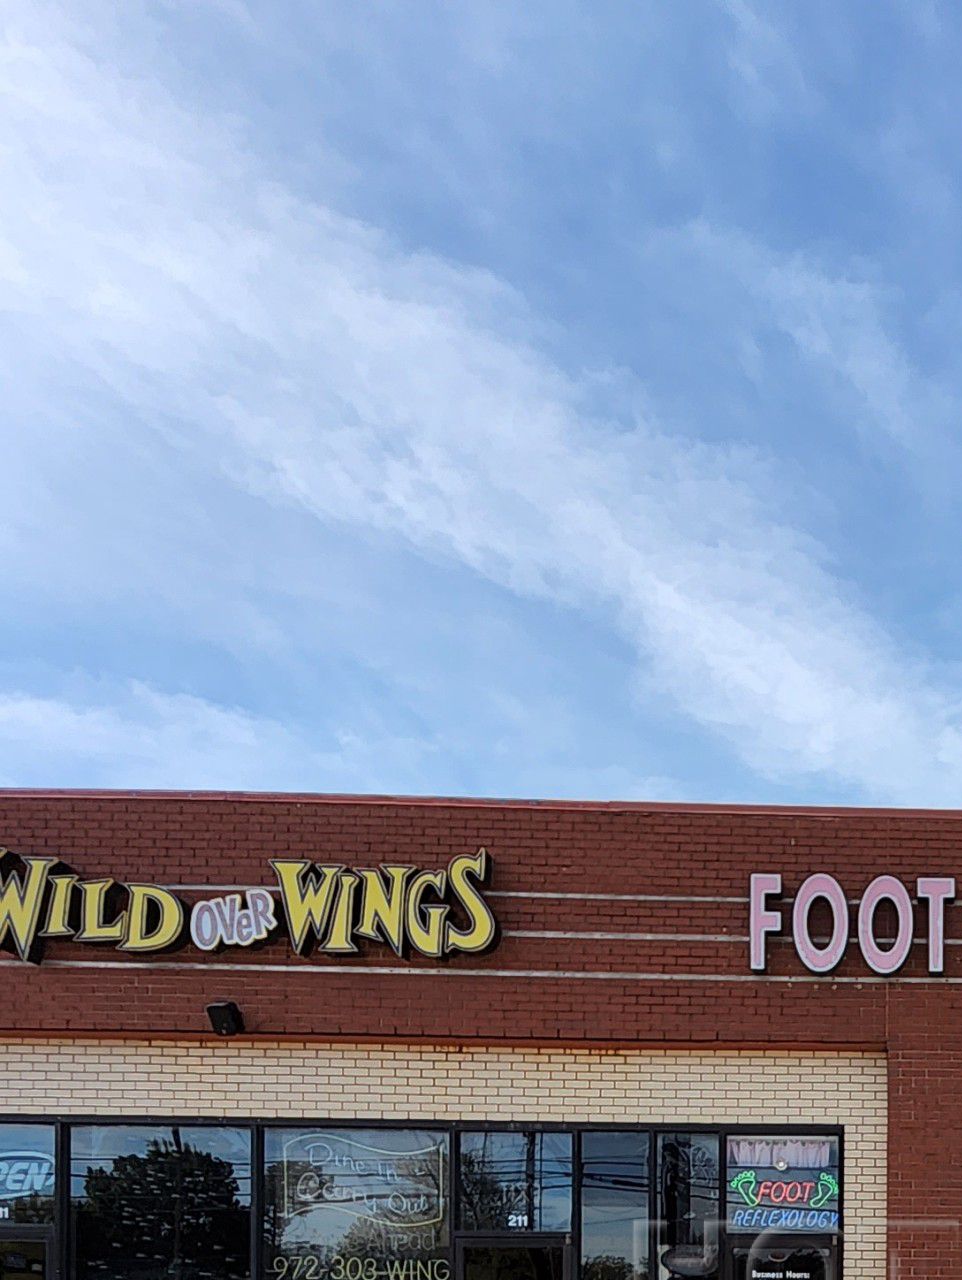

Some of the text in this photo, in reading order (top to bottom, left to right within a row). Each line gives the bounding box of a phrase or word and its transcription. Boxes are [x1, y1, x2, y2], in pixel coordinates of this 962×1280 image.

[268, 847, 495, 957] WINGS
[749, 873, 956, 975] FOOT
[758, 1181, 816, 1202] FOOT
[507, 1215, 528, 1227] 211
[732, 1210, 839, 1228] REFLEXOLOGY
